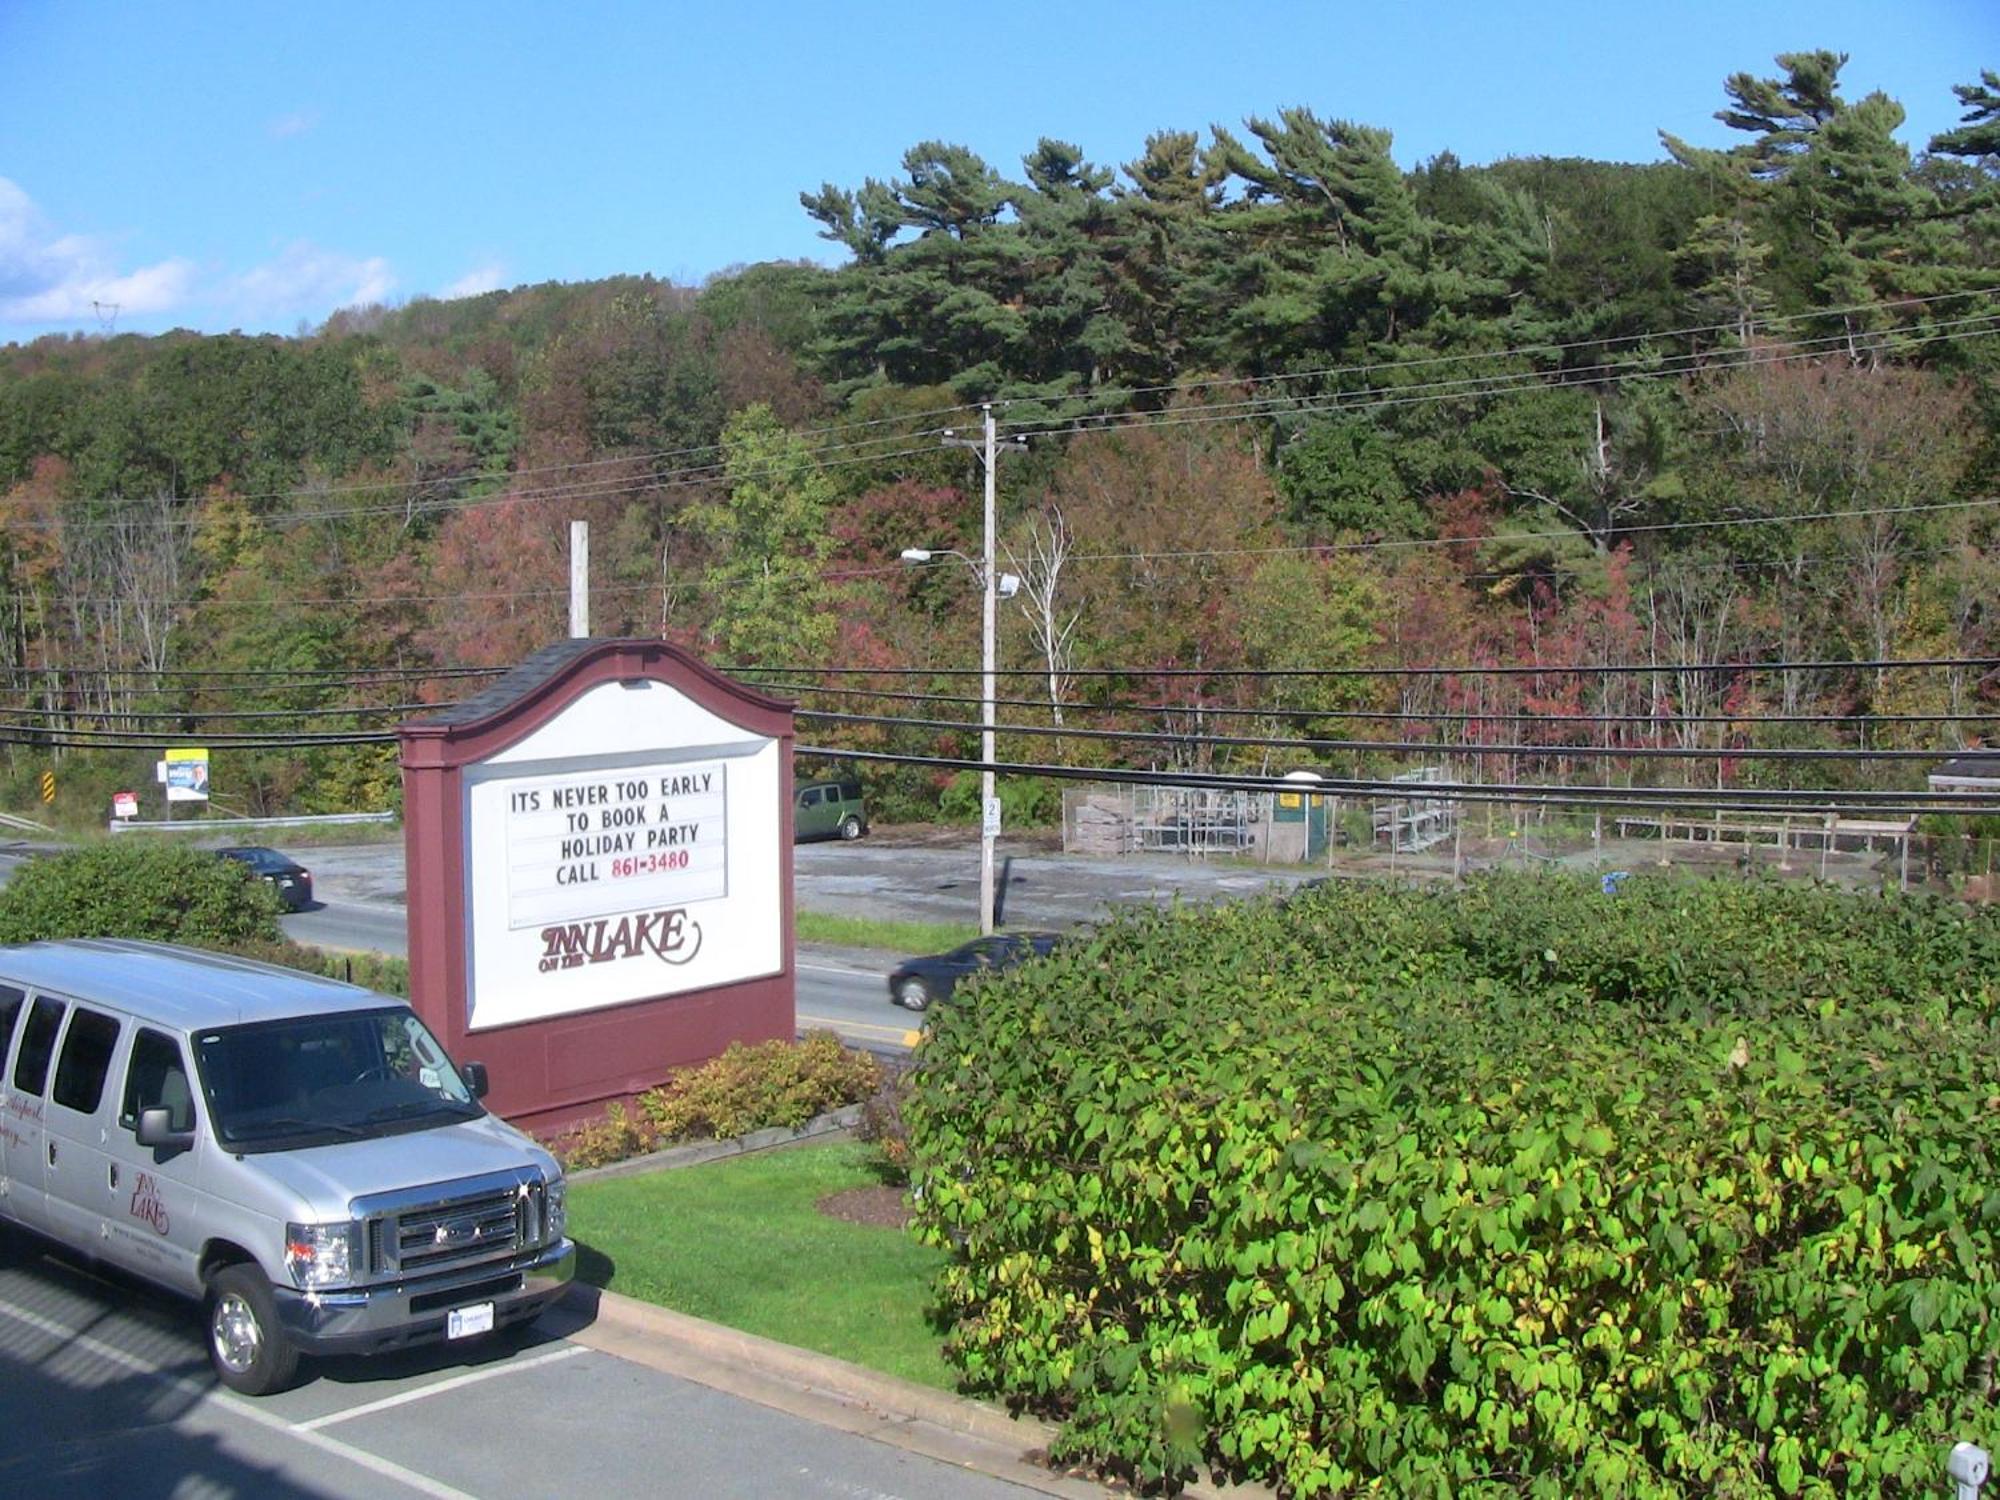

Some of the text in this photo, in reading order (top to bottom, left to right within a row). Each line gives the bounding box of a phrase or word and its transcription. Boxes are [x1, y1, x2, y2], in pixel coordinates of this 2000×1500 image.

[512, 773, 711, 813] ITS NEVER TOO EARLY
[988, 803, 995, 816] 2
[567, 803, 669, 833] TO BOOK A
[562, 823, 699, 860] HOLIDAY PARTY
[556, 850, 689, 885] CALL 861-3480
[541, 908, 703, 966] INN LAKE
